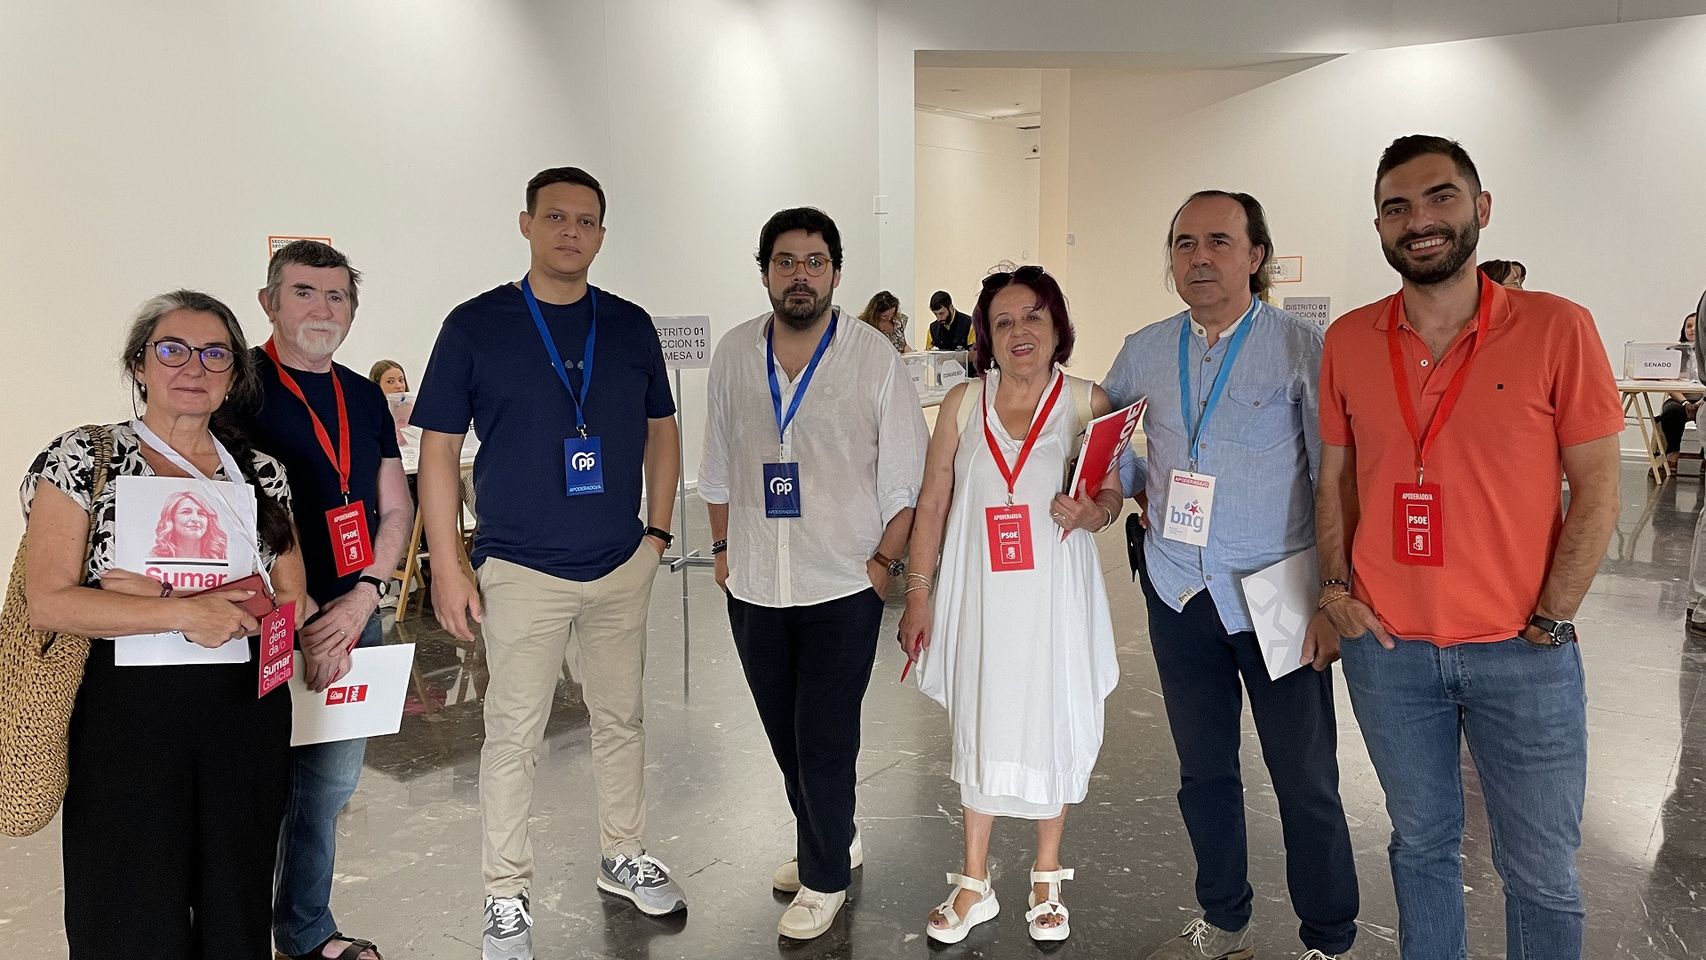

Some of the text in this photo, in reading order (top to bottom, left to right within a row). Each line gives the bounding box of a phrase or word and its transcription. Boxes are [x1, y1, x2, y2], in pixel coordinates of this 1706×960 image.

[656, 327, 704, 337] STRITO 01
[660, 339, 705, 349] CCION 15
[665, 351, 703, 360] MESA U
[1170, 505, 1204, 533] bng
[1408, 515, 1428, 525] PSOE
[342, 529, 358, 541] PSOE
[1001, 531, 1019, 539] PSOE
[145, 567, 228, 588] Sumar
[270, 618, 286, 633] Apo
[269, 628, 287, 645] dera
[263, 654, 291, 679] Sumar
[262, 667, 291, 691] Galicia
